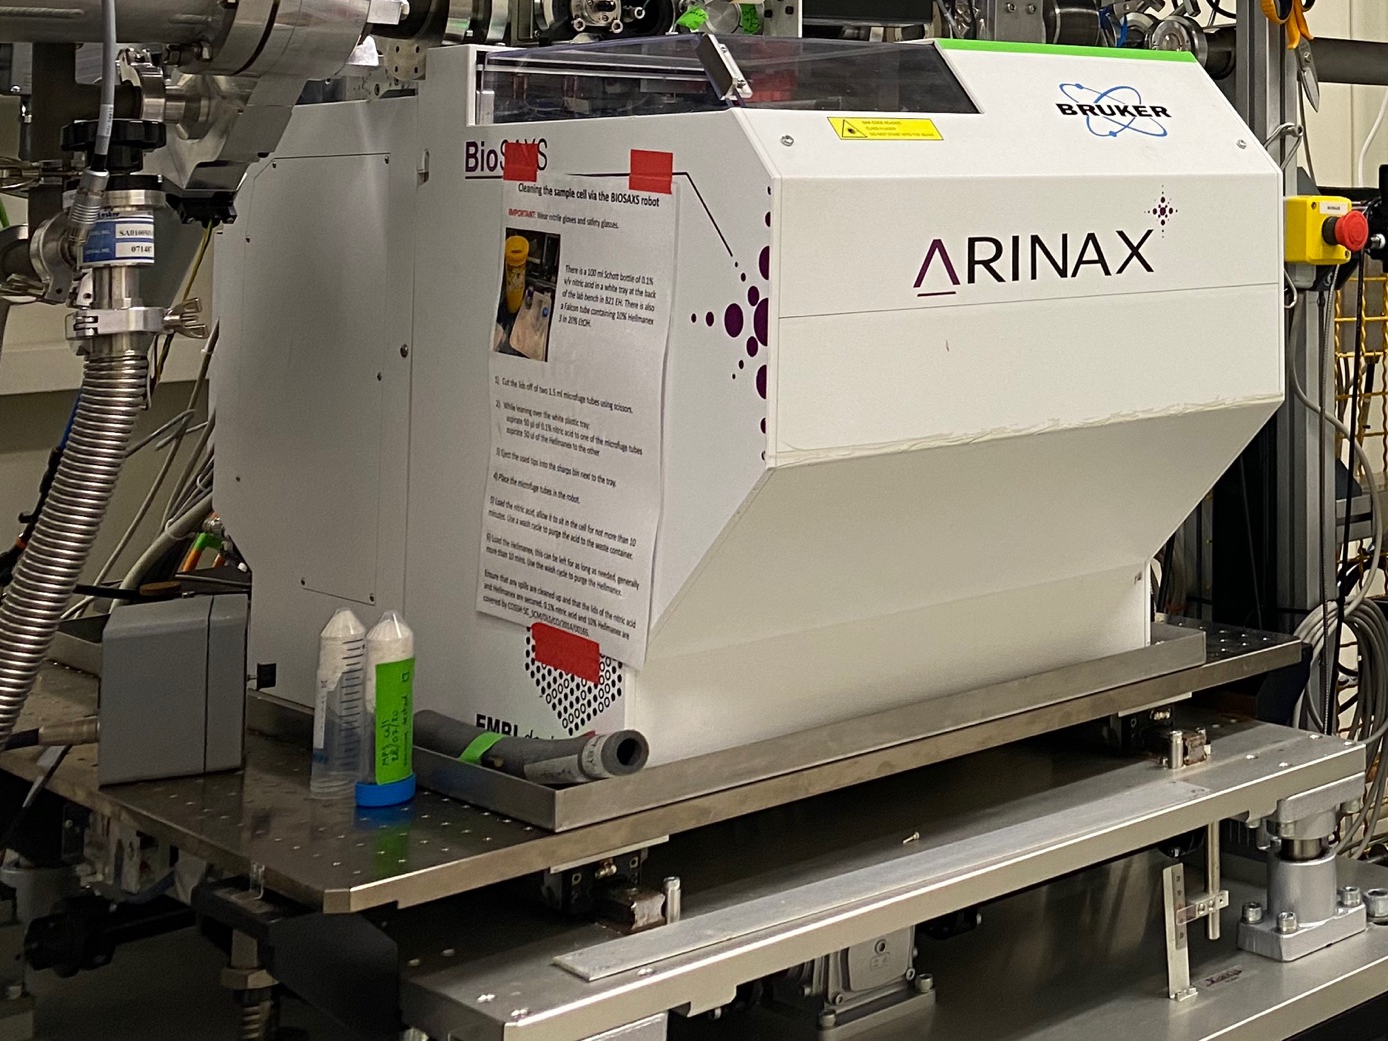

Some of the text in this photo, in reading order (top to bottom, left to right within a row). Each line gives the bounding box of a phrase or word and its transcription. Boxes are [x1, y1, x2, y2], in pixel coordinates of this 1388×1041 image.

[1056, 103, 1172, 118] BRUKER
[518, 183, 659, 207] Cleaning the sample cell via the BIOSAXS robot
[913, 229, 1154, 289] ARINAX
[566, 265, 578, 274] There
[588, 268, 596, 277] 100
[604, 270, 619, 280] Schott
[620, 273, 634, 283] bottle
[642, 276, 653, 285] 0.1%
[572, 279, 583, 288] nitric
[605, 284, 617, 293] white
[619, 286, 628, 295] tray
[635, 288, 643, 297] the
[645, 289, 656, 299] back
[564, 302, 578, 312] Falcon
[580, 306, 590, 314] tube
[591, 308, 616, 320] containing
[617, 311, 626, 320] 10%
[585, 293, 598, 302] bench
[605, 296, 614, 305] B21
[625, 299, 638, 309] There
[645, 303, 654, 312] also
[568, 316, 577, 325] 20%
